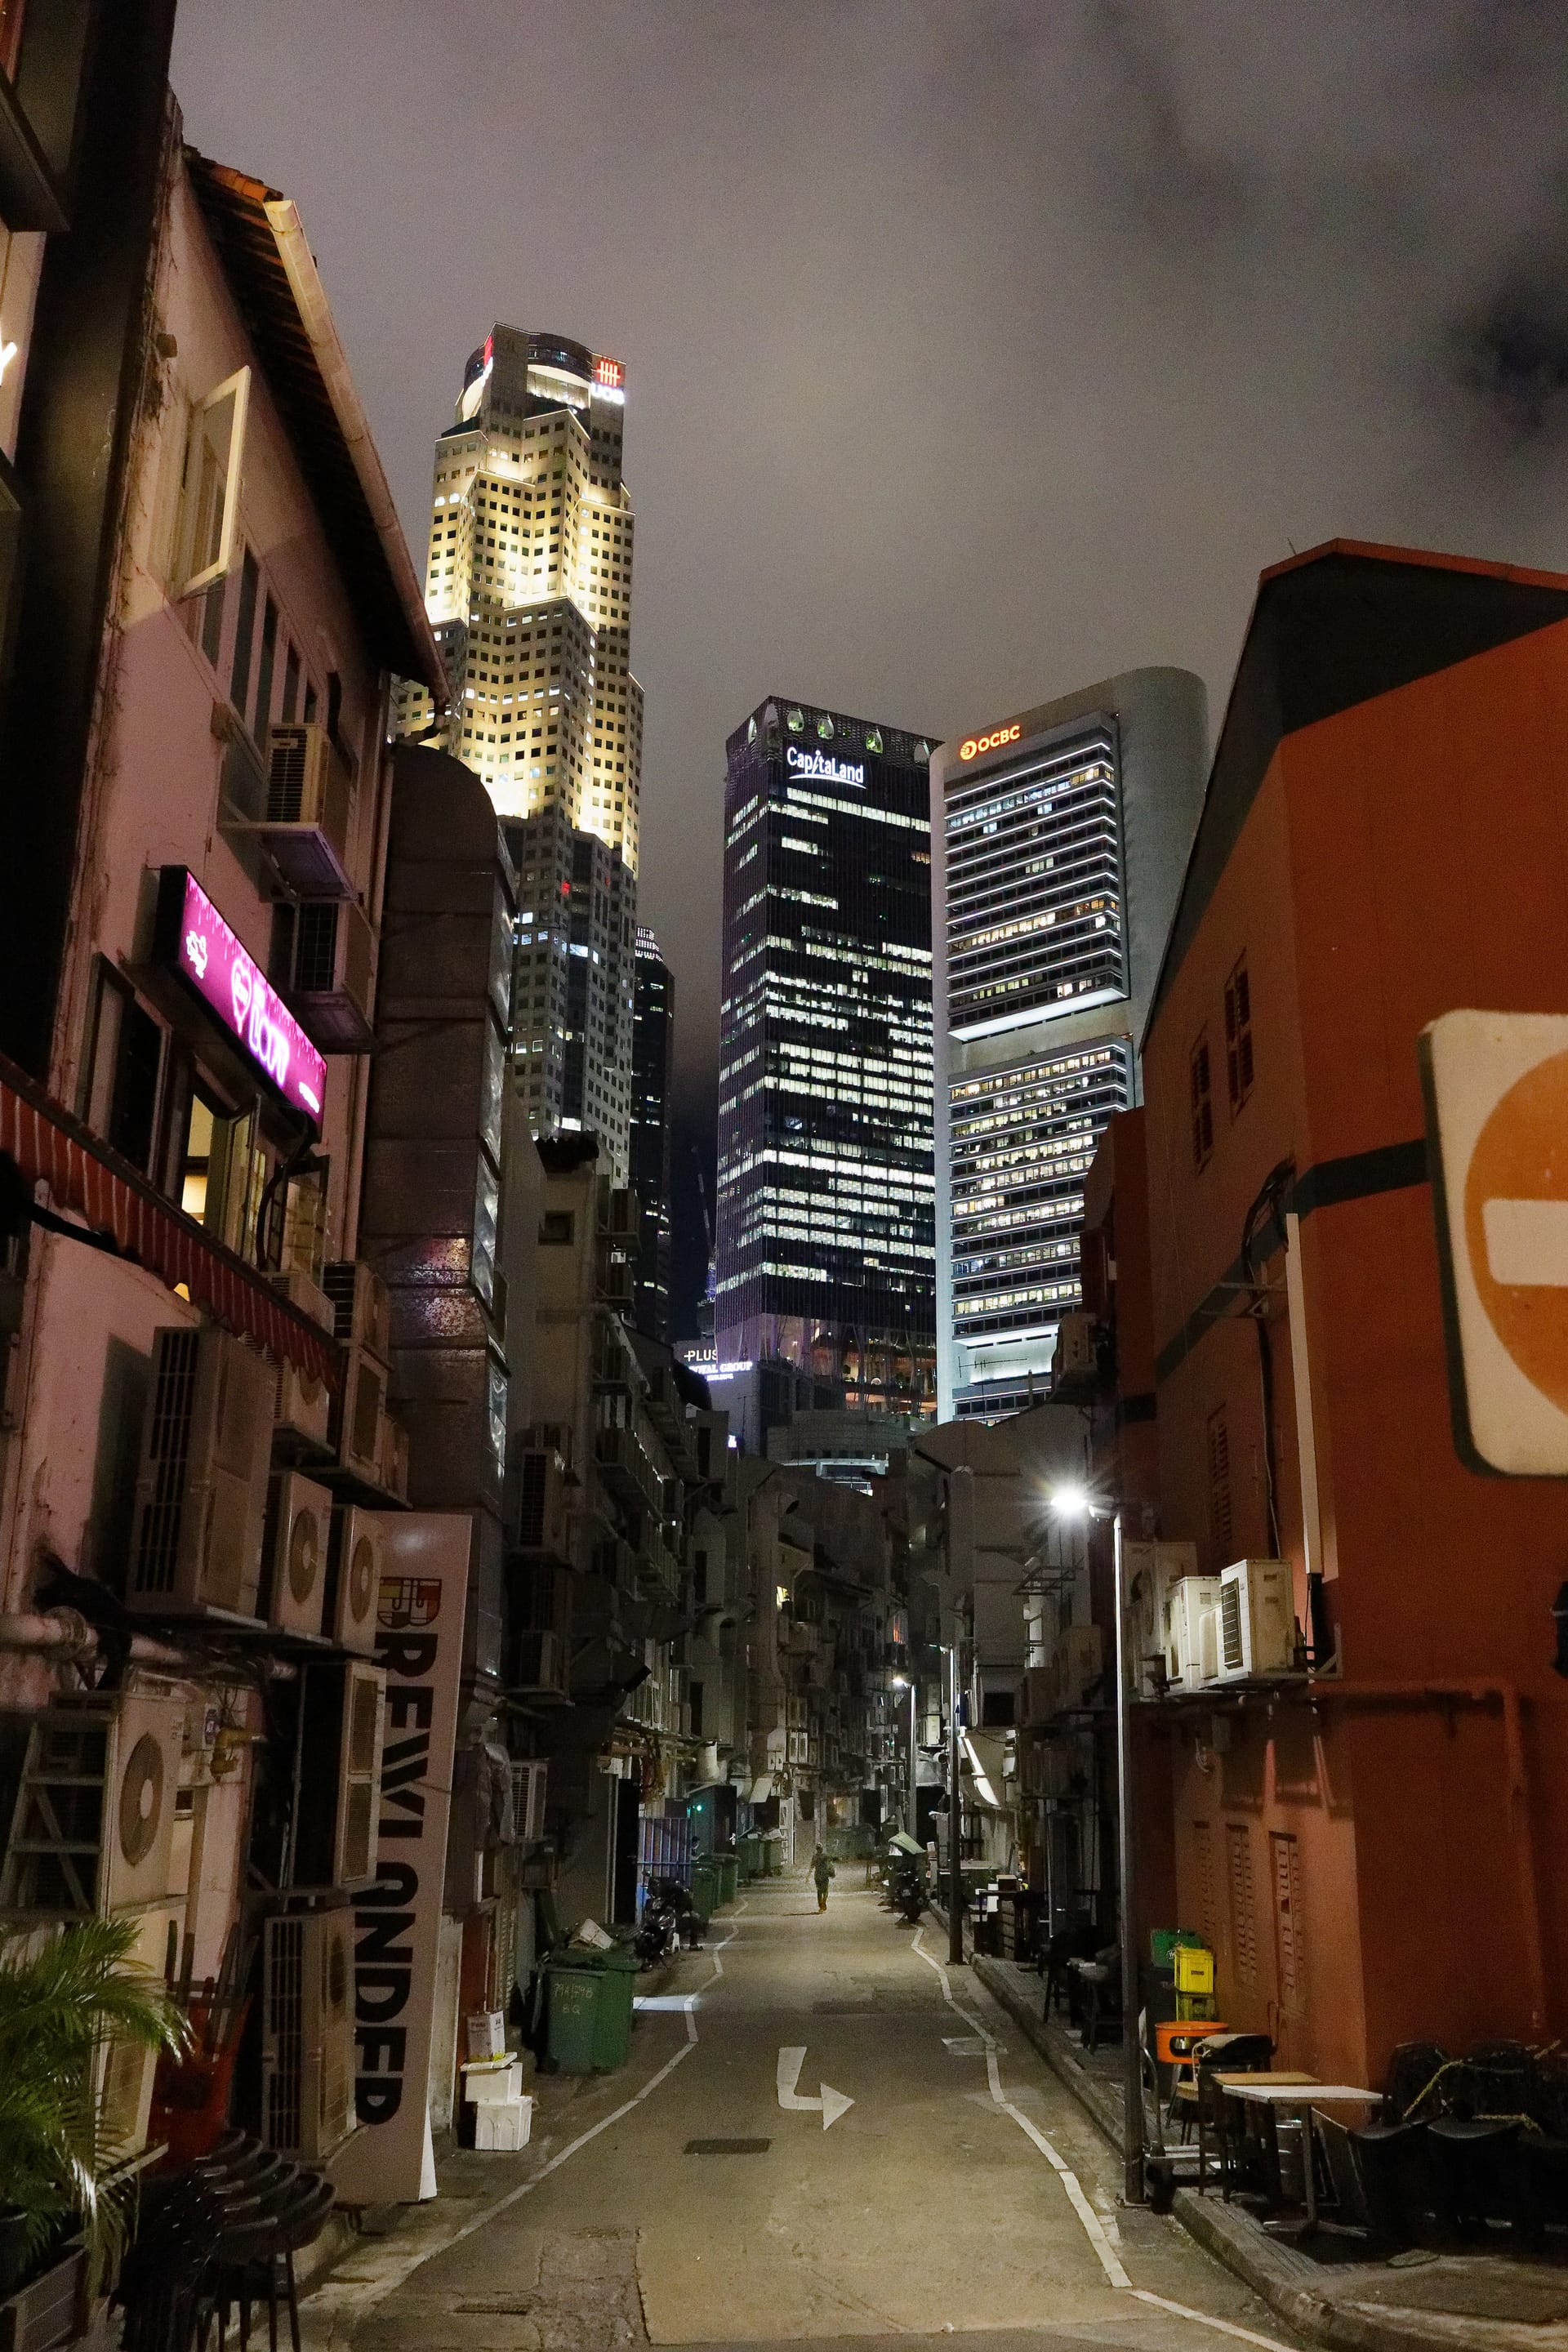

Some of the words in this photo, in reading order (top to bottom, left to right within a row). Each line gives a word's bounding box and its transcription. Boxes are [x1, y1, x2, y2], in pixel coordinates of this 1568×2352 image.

[590, 382, 625, 404] UOB
[978, 724, 1021, 752] OCBC
[786, 746, 864, 784] CapitaLand
[719, 1361, 753, 1373] GROUP
